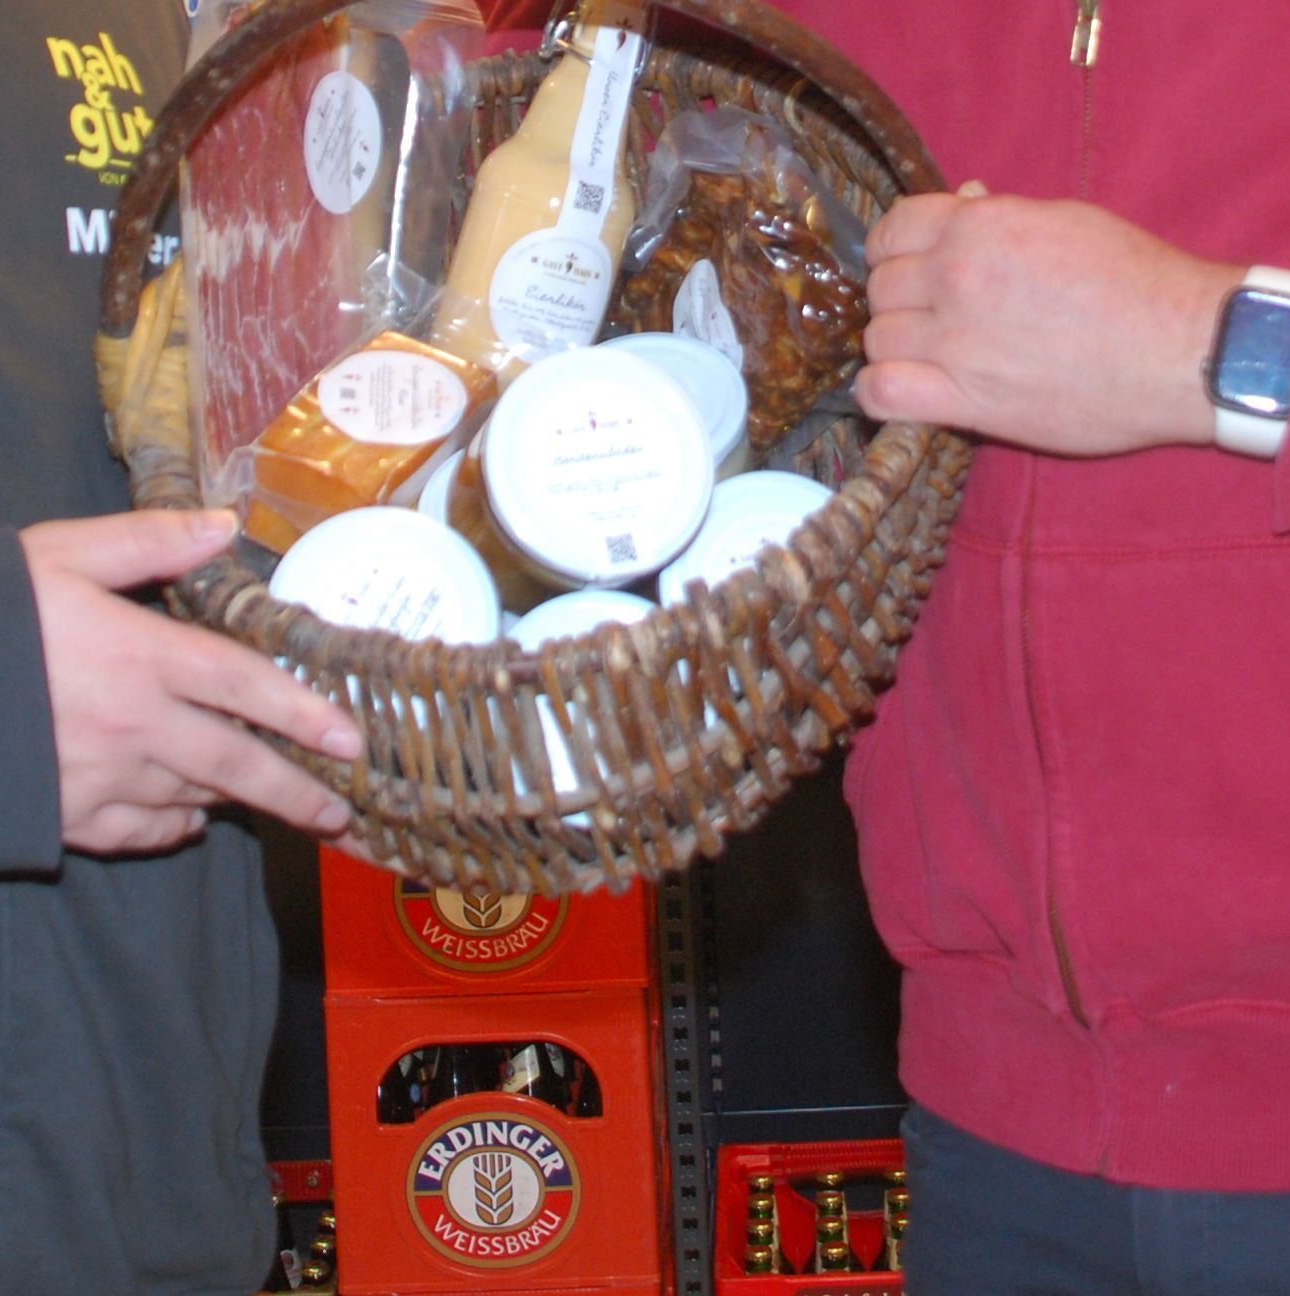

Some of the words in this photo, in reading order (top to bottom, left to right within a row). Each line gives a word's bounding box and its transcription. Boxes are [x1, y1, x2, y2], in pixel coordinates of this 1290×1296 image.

[46, 31, 143, 95] nah
[69, 103, 155, 170] gut
[420, 910, 550, 959] WEISSBRÄU
[417, 1120, 566, 1183] ERDINGER
[433, 1207, 562, 1256] WEISSBRÄU
